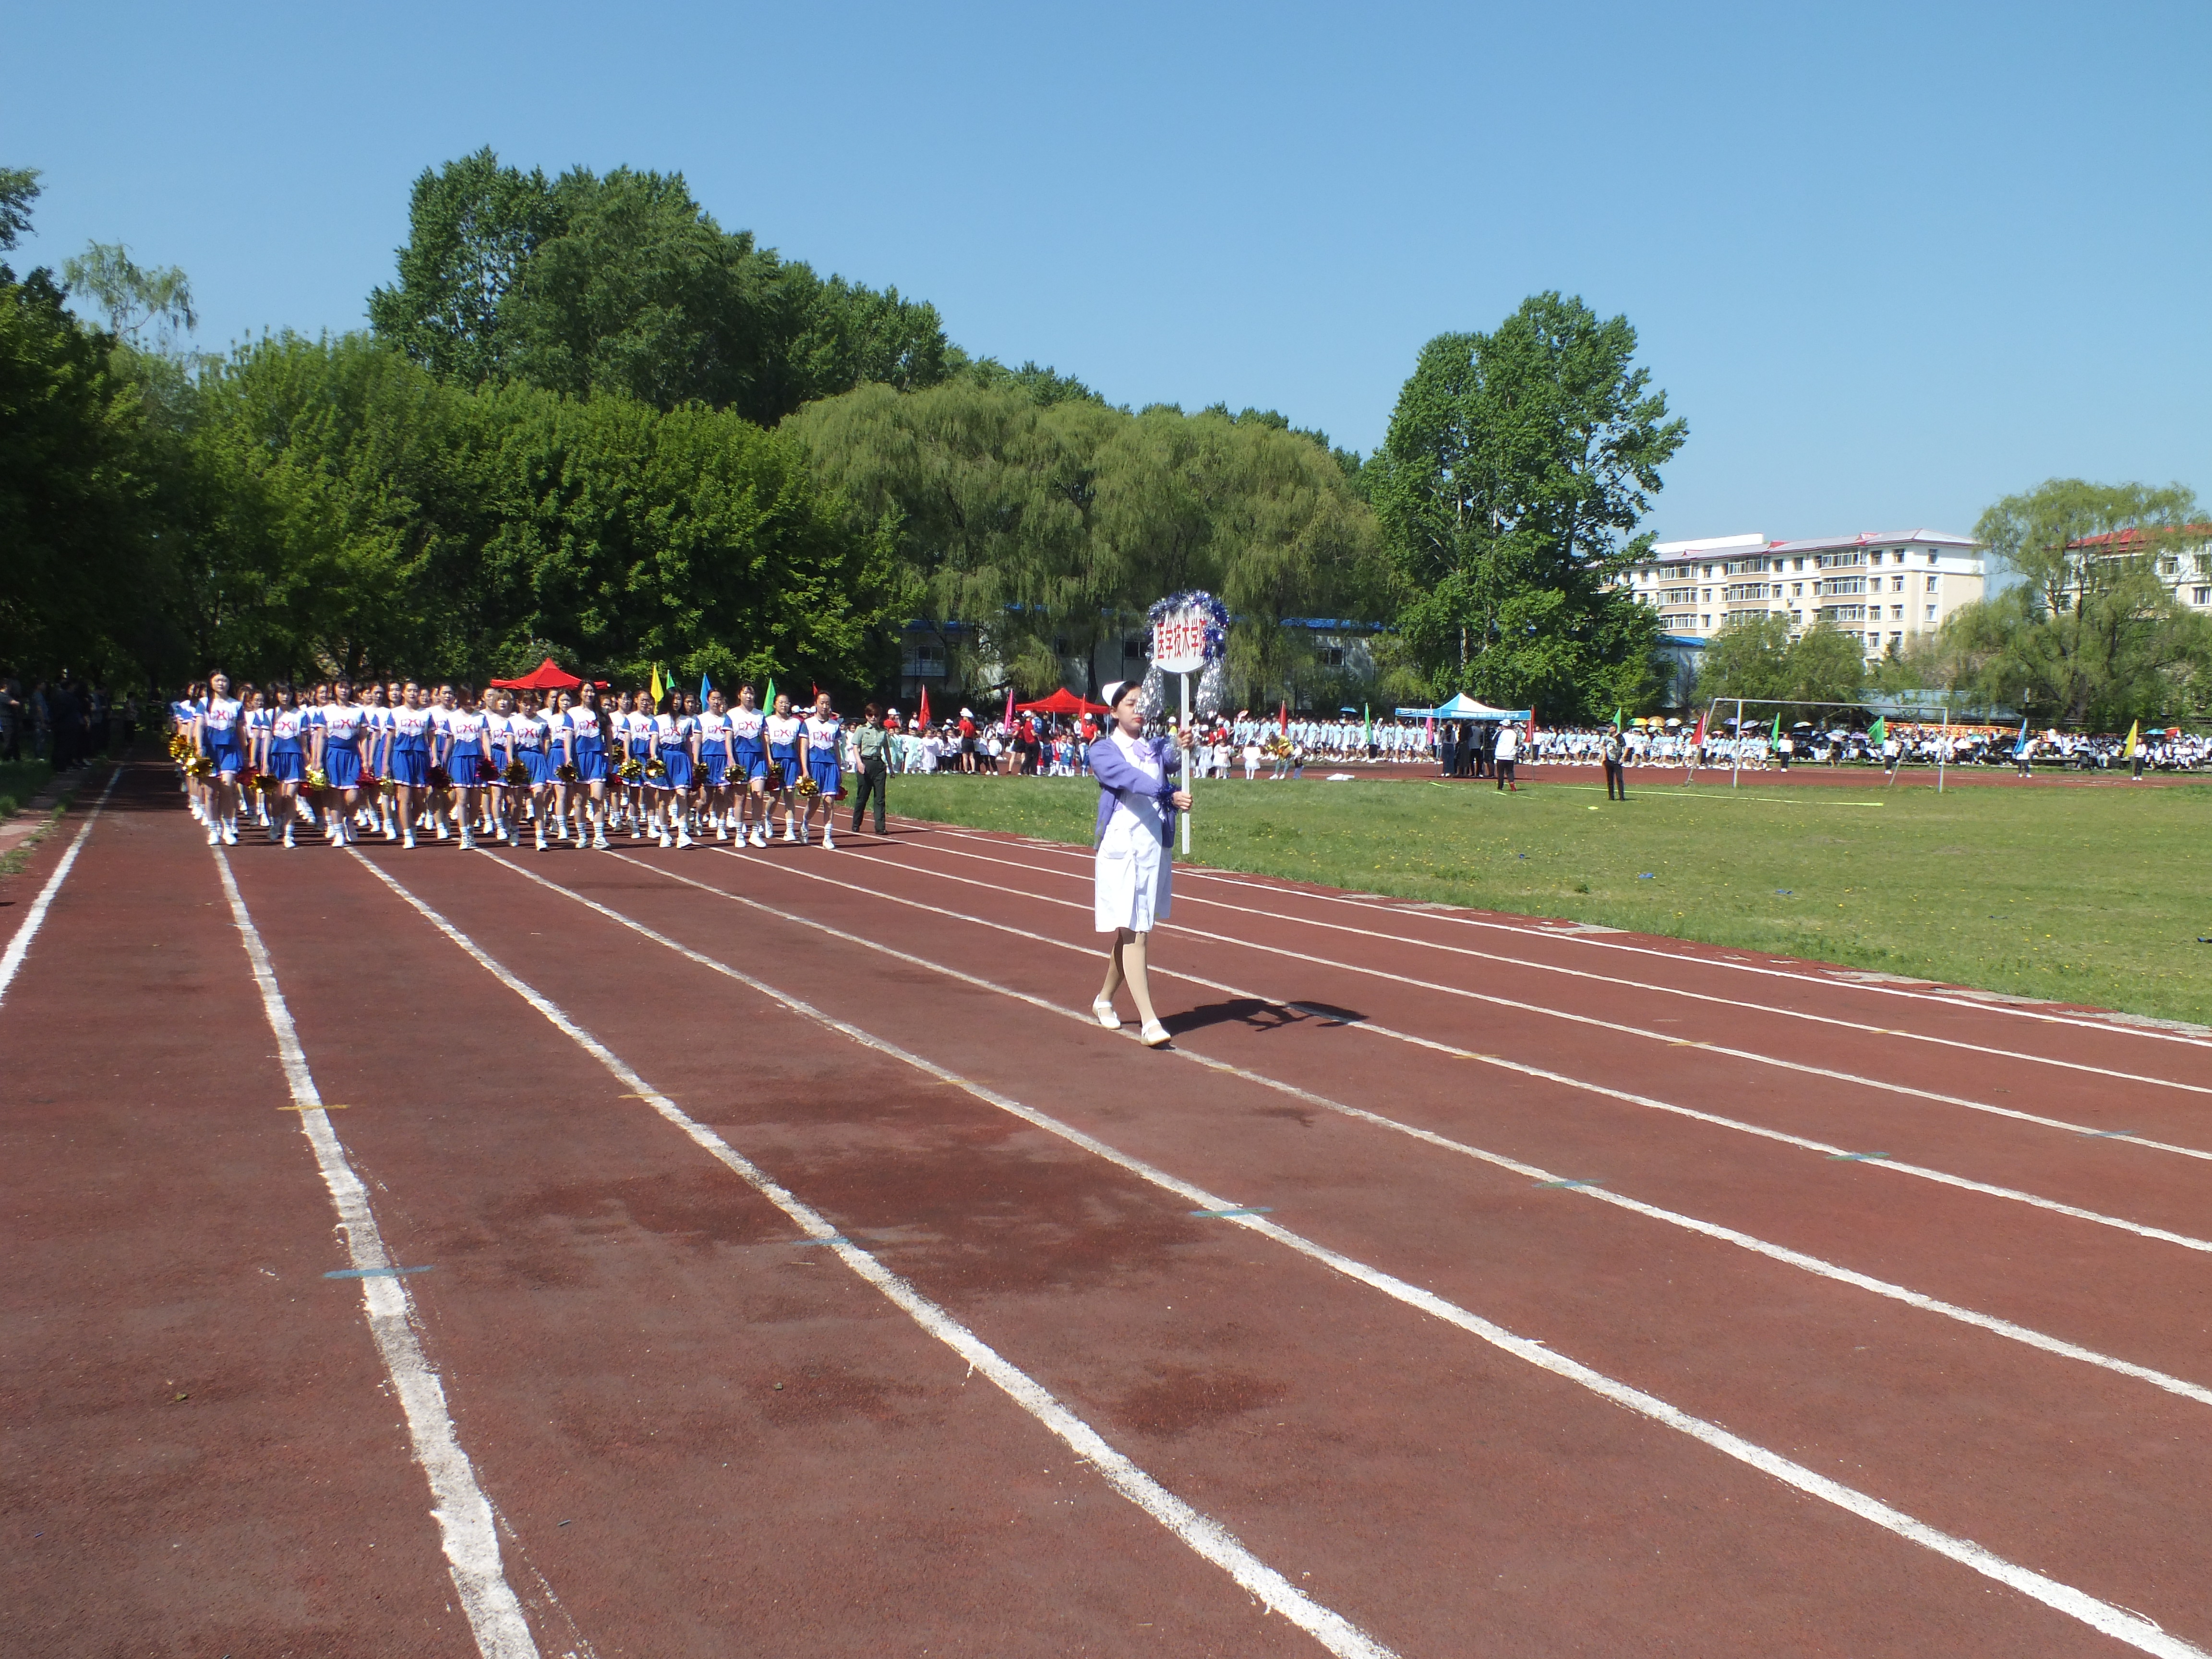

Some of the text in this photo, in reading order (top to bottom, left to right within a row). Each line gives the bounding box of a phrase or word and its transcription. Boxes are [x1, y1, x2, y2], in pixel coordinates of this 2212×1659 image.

[333, 719, 358, 729] CXU
[400, 719, 426, 727] CXU
[738, 721, 760, 730] CXU
[457, 724, 480, 733] CXU
[813, 731, 834, 742] CXU
